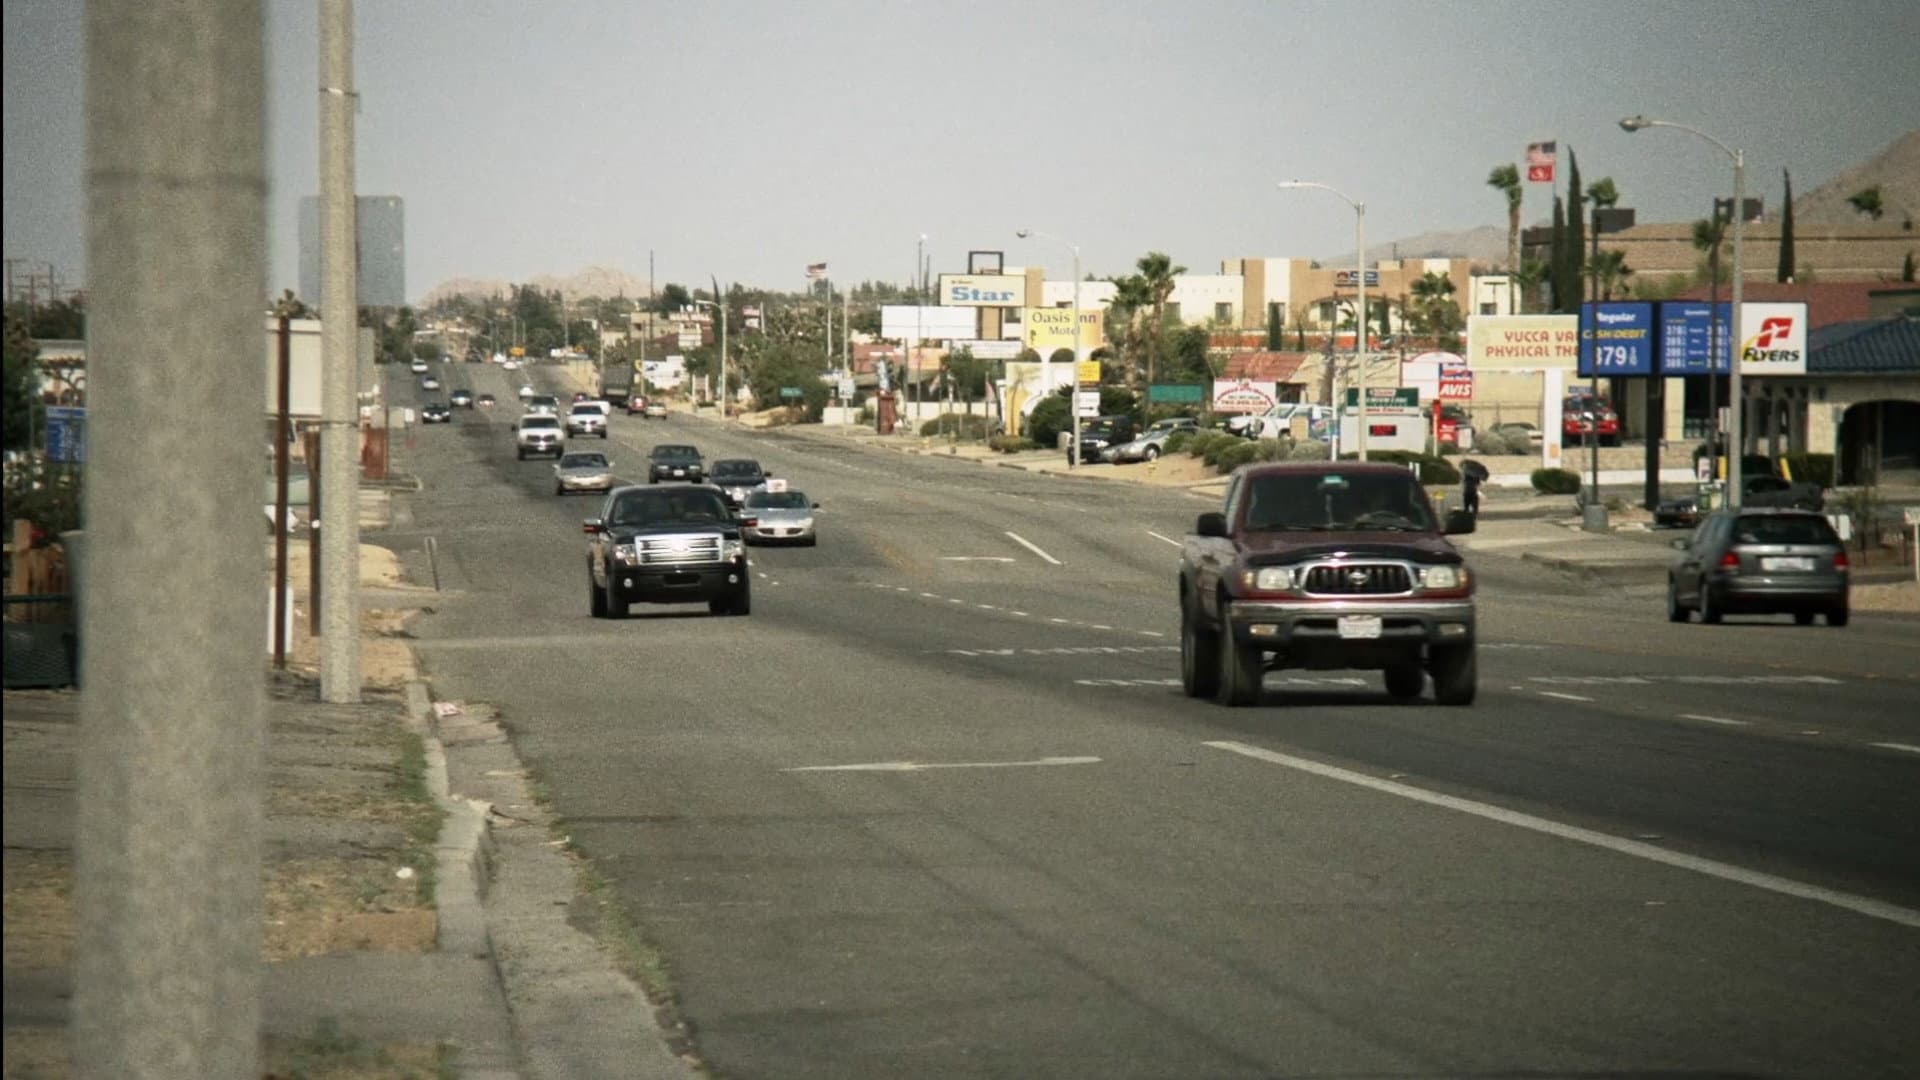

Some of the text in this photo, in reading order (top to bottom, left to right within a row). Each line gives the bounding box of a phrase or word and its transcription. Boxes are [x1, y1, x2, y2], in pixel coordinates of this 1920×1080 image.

[951, 286, 1015, 301] Star
[1032, 312, 1070, 324] Oasis
[1596, 312, 1636, 324] Regular
[1504, 331, 1549, 342] YUCCA
[1486, 345, 1550, 357] PHYSICAL
[1743, 347, 1800, 362] FLYERS
[1440, 384, 1471, 396] AVIS
